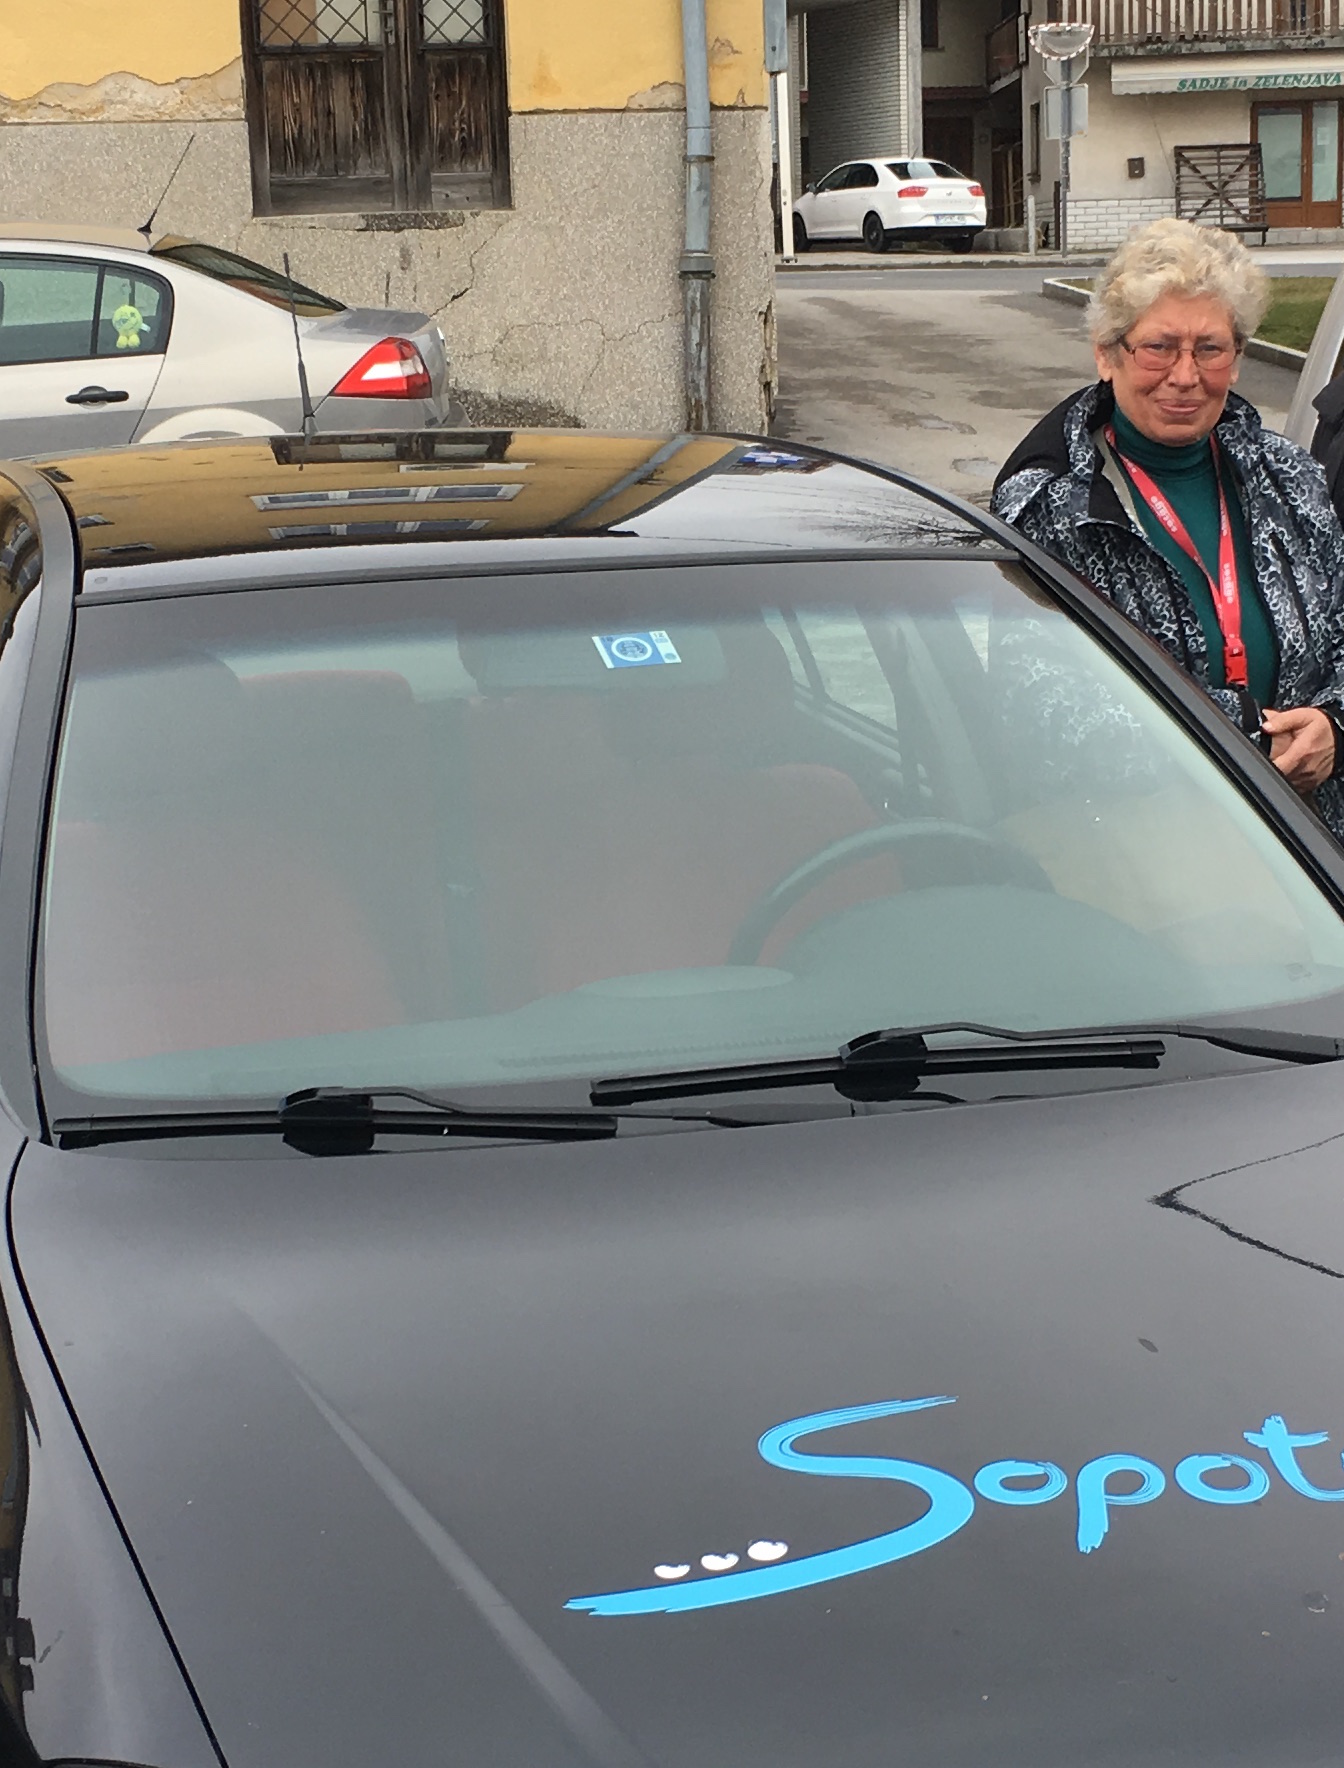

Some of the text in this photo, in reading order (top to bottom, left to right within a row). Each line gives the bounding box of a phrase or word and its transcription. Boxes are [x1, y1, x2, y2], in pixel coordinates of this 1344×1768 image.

[1177, 76, 1231, 91] SADJE
[1233, 76, 1248, 88] in
[1252, 72, 1342, 88] ZELENJAVA
